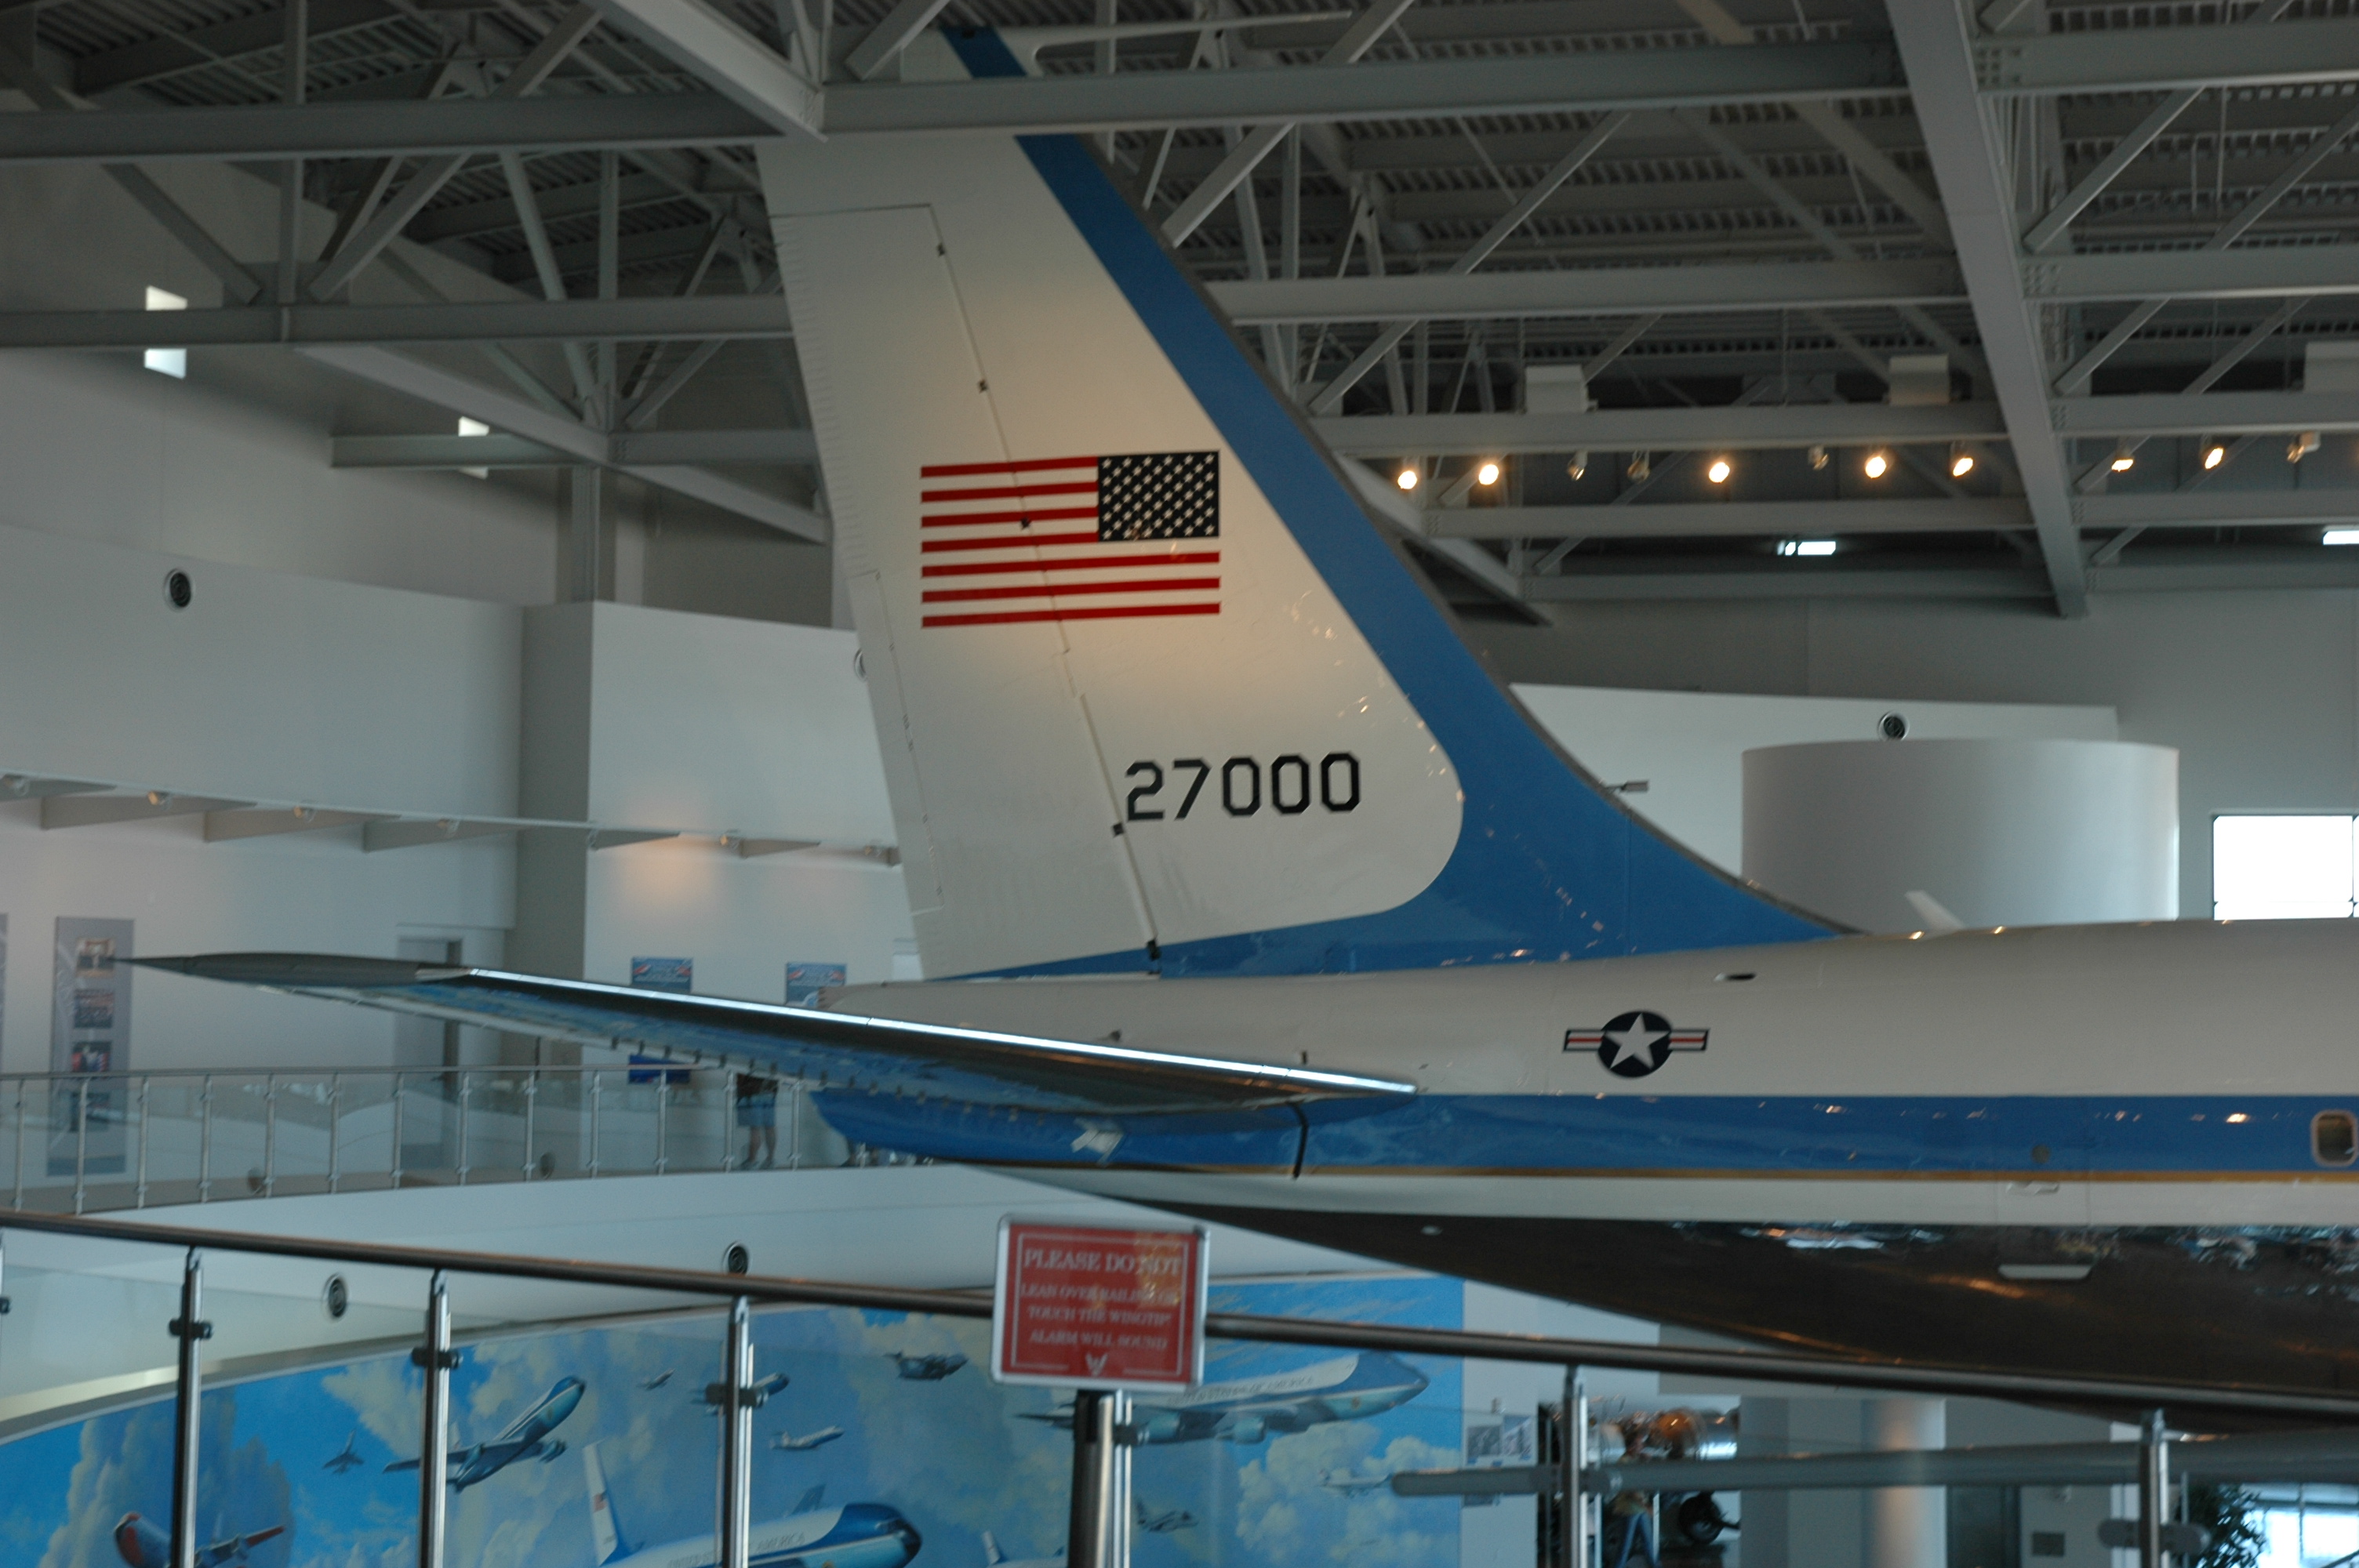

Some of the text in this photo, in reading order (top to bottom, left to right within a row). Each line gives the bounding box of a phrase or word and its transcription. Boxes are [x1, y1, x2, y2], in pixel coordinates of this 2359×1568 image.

[1125, 752, 1361, 822] 27000
[1023, 1248, 1183, 1276] PLEASE DO NOT
[1020, 1283, 1056, 1298] LEAN
[1058, 1286, 1099, 1301] OVER
[1028, 1305, 1074, 1322] TOUCH
[1079, 1308, 1107, 1323] THE
[1029, 1329, 1168, 1350] ALARM WILL SOUND
